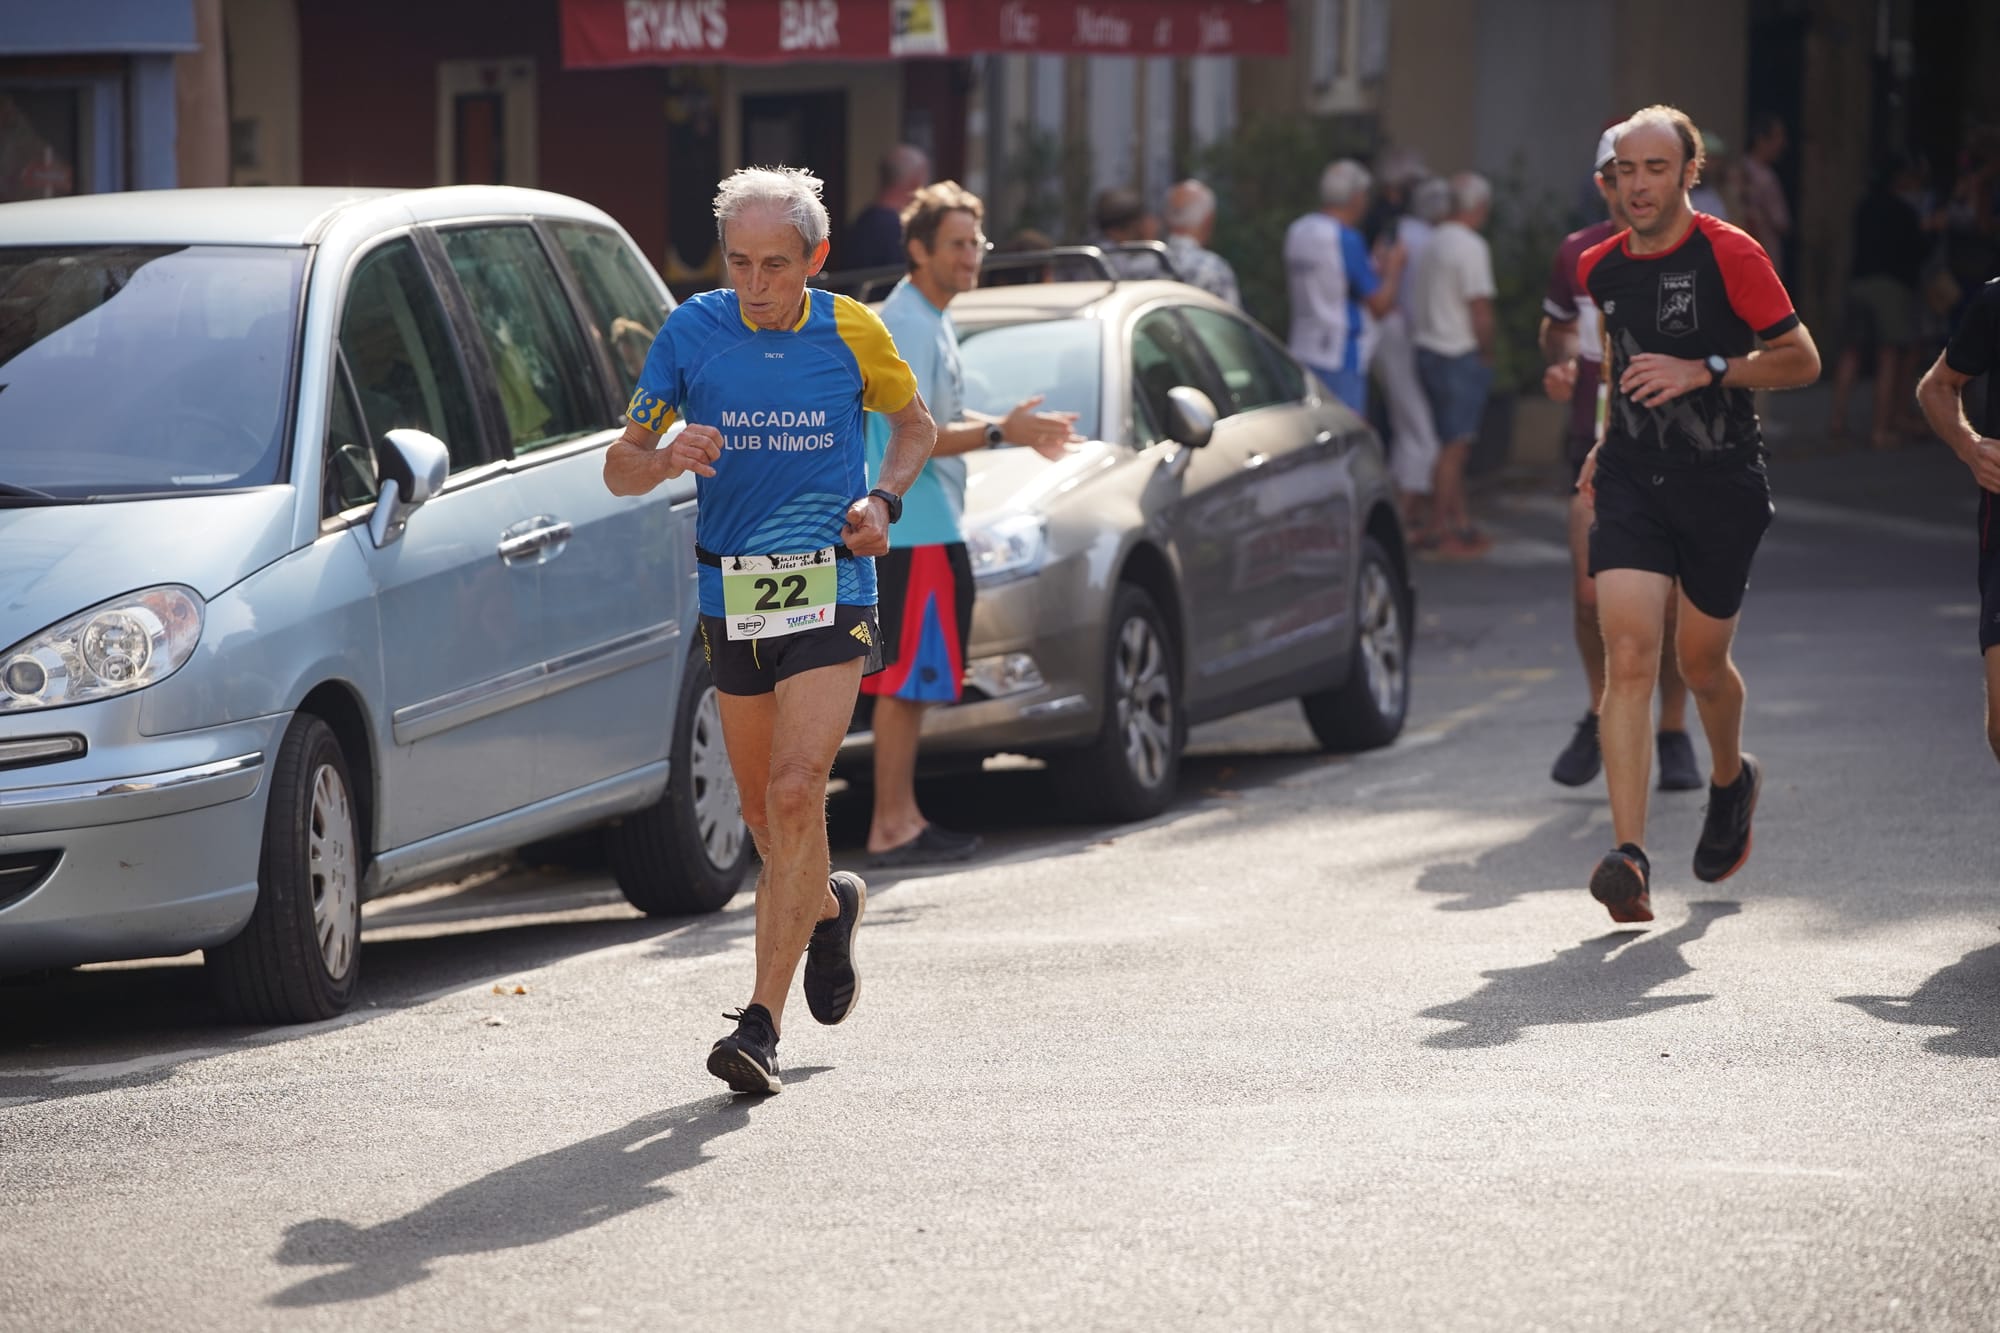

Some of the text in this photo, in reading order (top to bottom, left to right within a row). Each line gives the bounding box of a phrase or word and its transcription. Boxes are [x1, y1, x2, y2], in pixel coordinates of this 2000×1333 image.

[780, 0, 840, 50] BAR
[722, 411, 826, 428] MACADAM
[723, 432, 834, 452] LUB NÎMOIS
[754, 575, 809, 611] 22
[737, 621, 762, 631] BFP
[786, 613, 816, 625] TUFF'S
